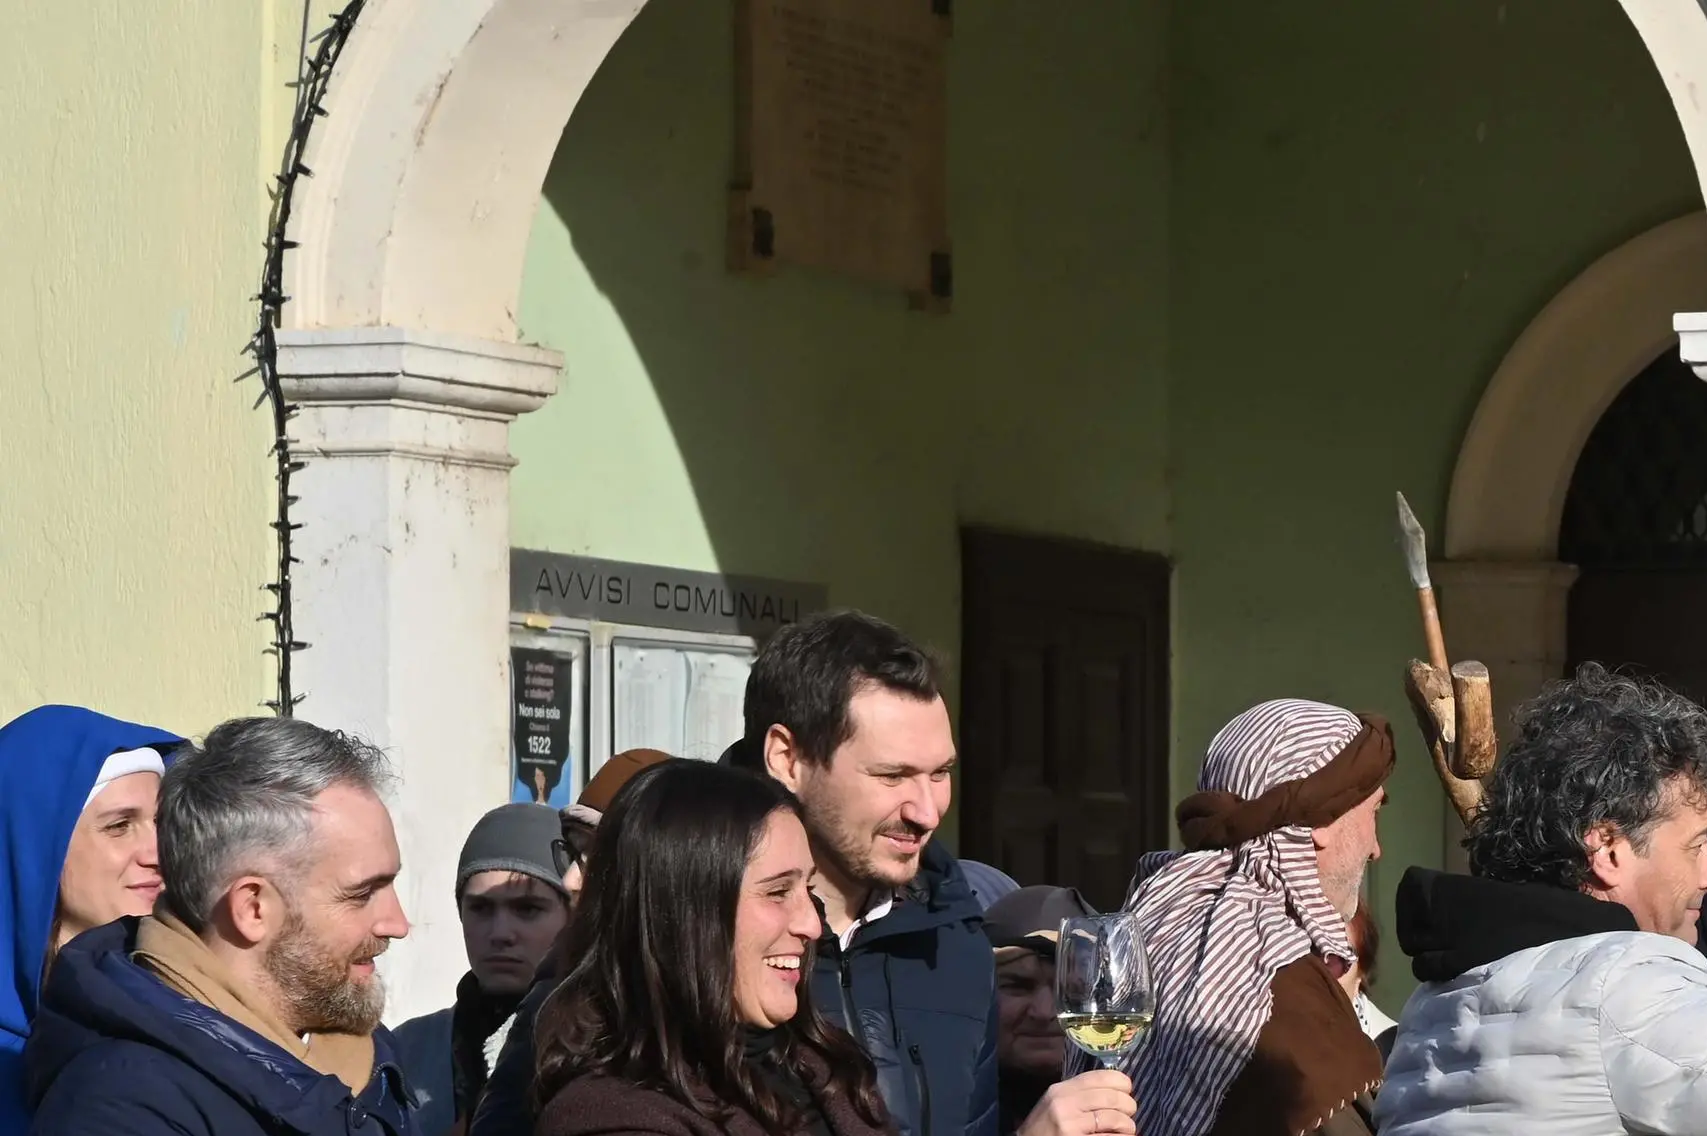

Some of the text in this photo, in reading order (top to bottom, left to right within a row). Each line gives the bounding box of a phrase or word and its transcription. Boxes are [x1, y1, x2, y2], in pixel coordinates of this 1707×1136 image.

[535, 568, 799, 624] AVVISI COMUNALI
[519, 703, 561, 720] Non sei sola
[528, 735, 551, 755] 1522
